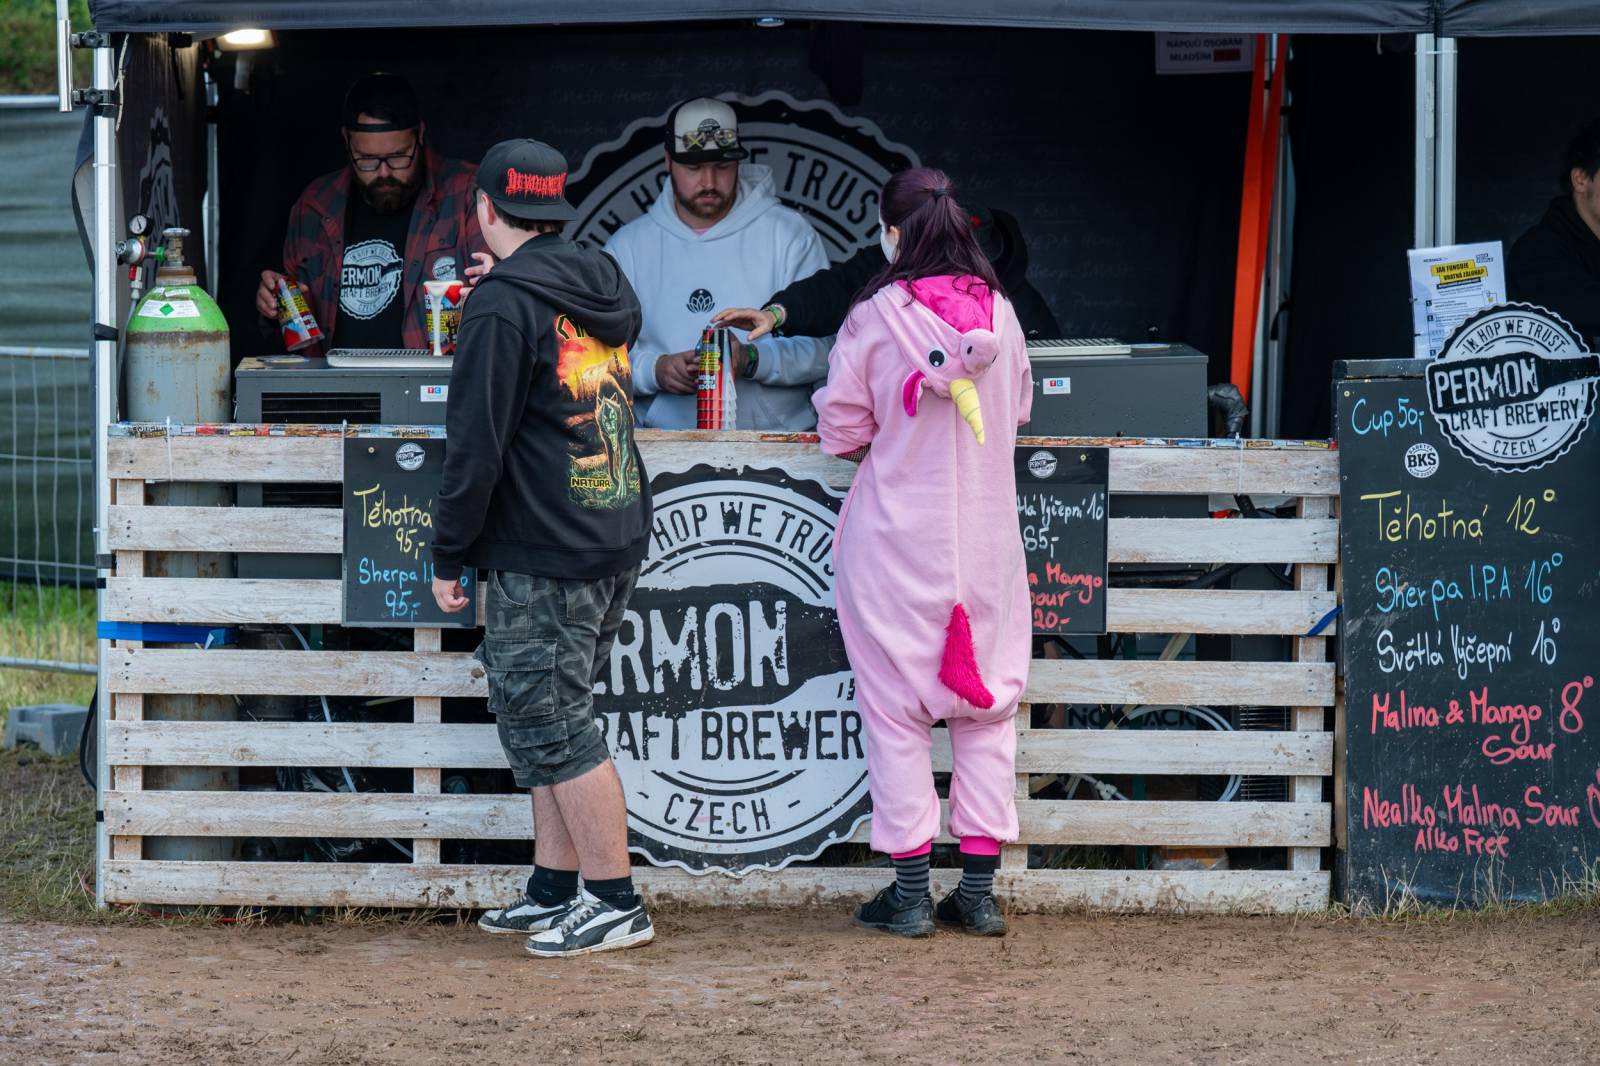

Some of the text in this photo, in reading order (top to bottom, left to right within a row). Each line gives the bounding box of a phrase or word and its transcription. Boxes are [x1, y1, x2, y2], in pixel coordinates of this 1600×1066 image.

[784, 151, 880, 238] TRUS
[342, 265, 382, 286] ERMON
[1477, 321, 1501, 343] HOP
[1505, 319, 1524, 335] WE
[1528, 321, 1566, 352] TRUST
[1433, 358, 1539, 407] PERMON
[1351, 399, 1394, 437] Cup
[1451, 399, 1580, 432] CRAFT BREWERY
[1407, 452, 1437, 468] BKS
[1493, 440, 1537, 456] CZECH
[1360, 490, 1488, 542] Těhotná
[652, 501, 834, 576] HOP WE TRU
[358, 557, 418, 589] Sherpa
[1045, 562, 1103, 604] Mango
[1375, 567, 1463, 622] Sherpa
[592, 600, 790, 697] RMON
[1376, 629, 1444, 673] Světlá
[594, 710, 865, 760] RAFT BREWER
[1371, 689, 1440, 735] Malina
[1445, 699, 1465, 724] &
[1469, 686, 1542, 744] Mango
[1482, 735, 1556, 765] Sour
[664, 793, 771, 835] CZECH
[1364, 783, 1436, 830] Nealko
[1443, 783, 1521, 830] Malina
[1524, 786, 1580, 826] Sour
[1415, 828, 1510, 858] Alko Free
